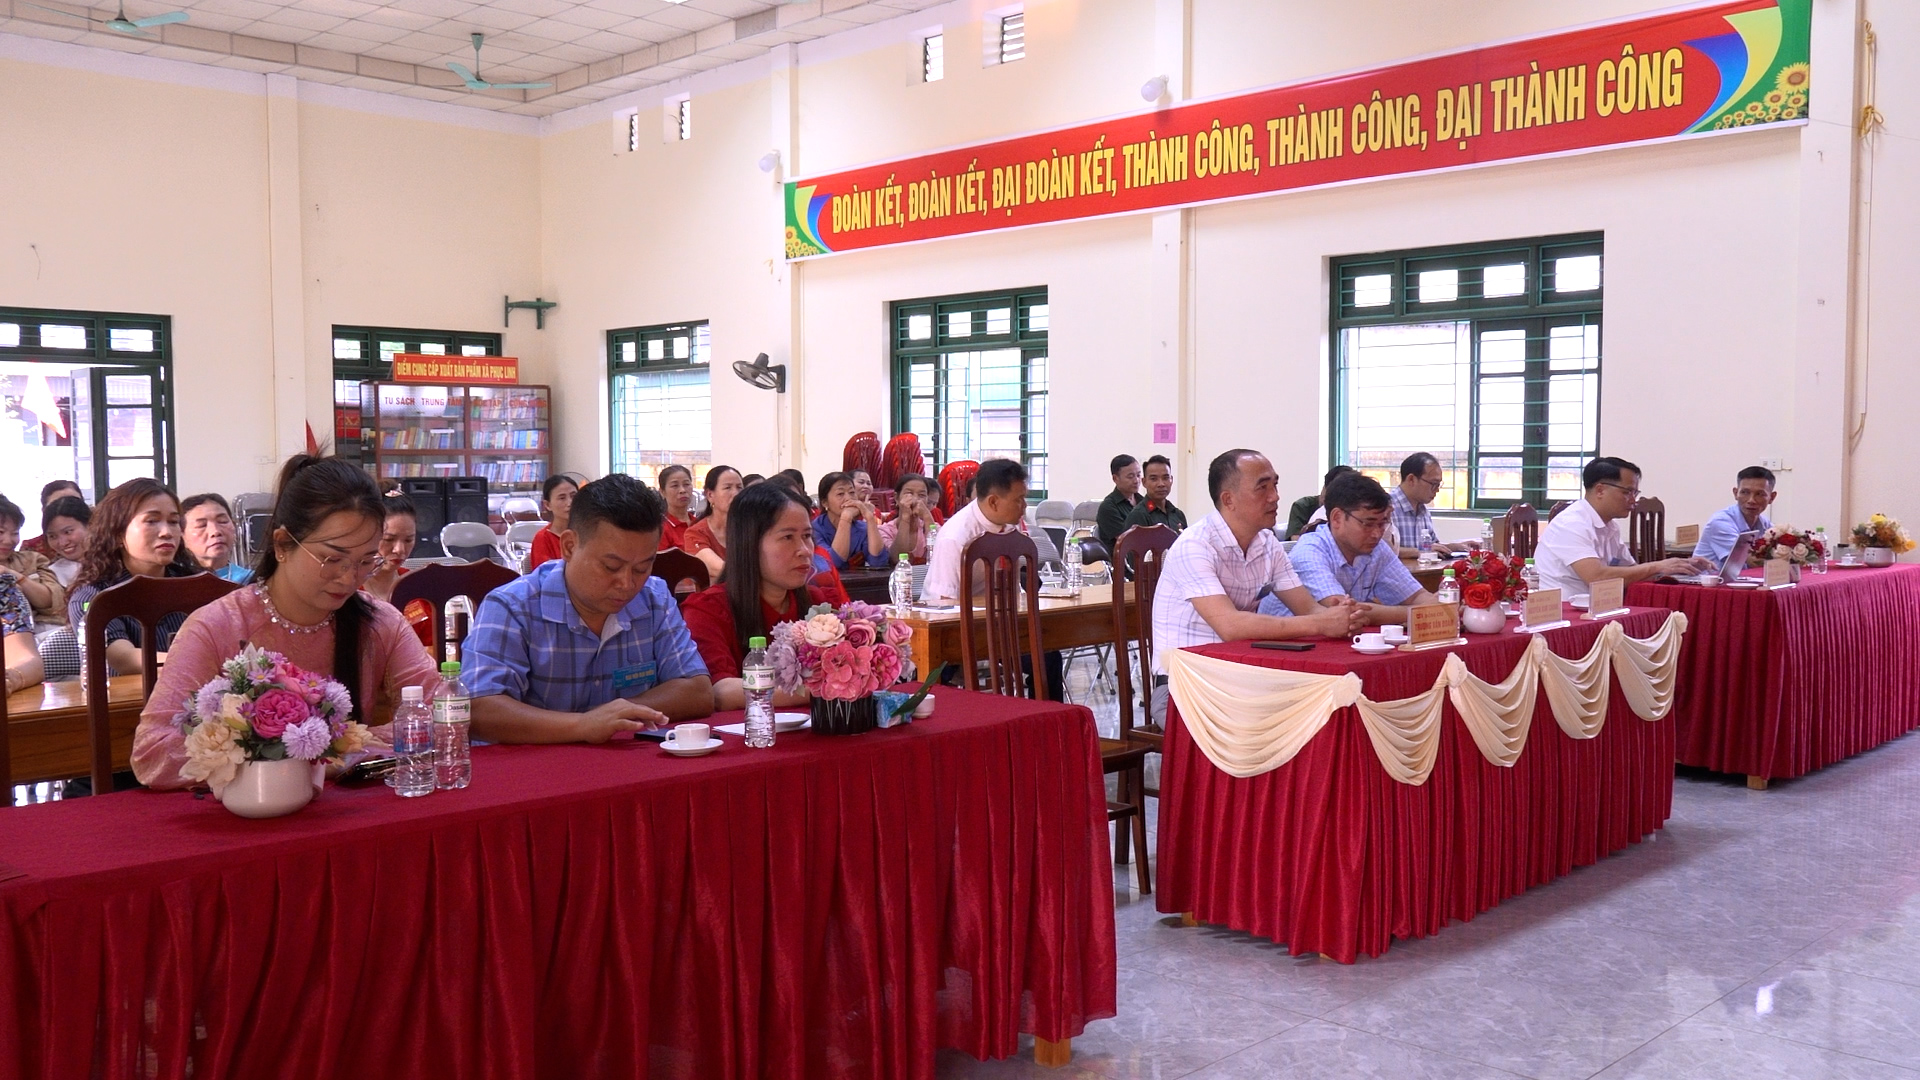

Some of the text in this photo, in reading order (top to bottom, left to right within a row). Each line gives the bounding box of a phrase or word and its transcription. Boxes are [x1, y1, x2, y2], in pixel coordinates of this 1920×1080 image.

[832, 44, 1685, 233] ĐOÀN KẾT, ĐOÀN KẾT, ĐẠI ĐOÀN KẾT, THÀNH CÔNG, THÀNH CÔNG, ĐẠI THÀNH CÔNG
[412, 362, 428, 377] CUNG
[505, 366, 516, 379] LINH
